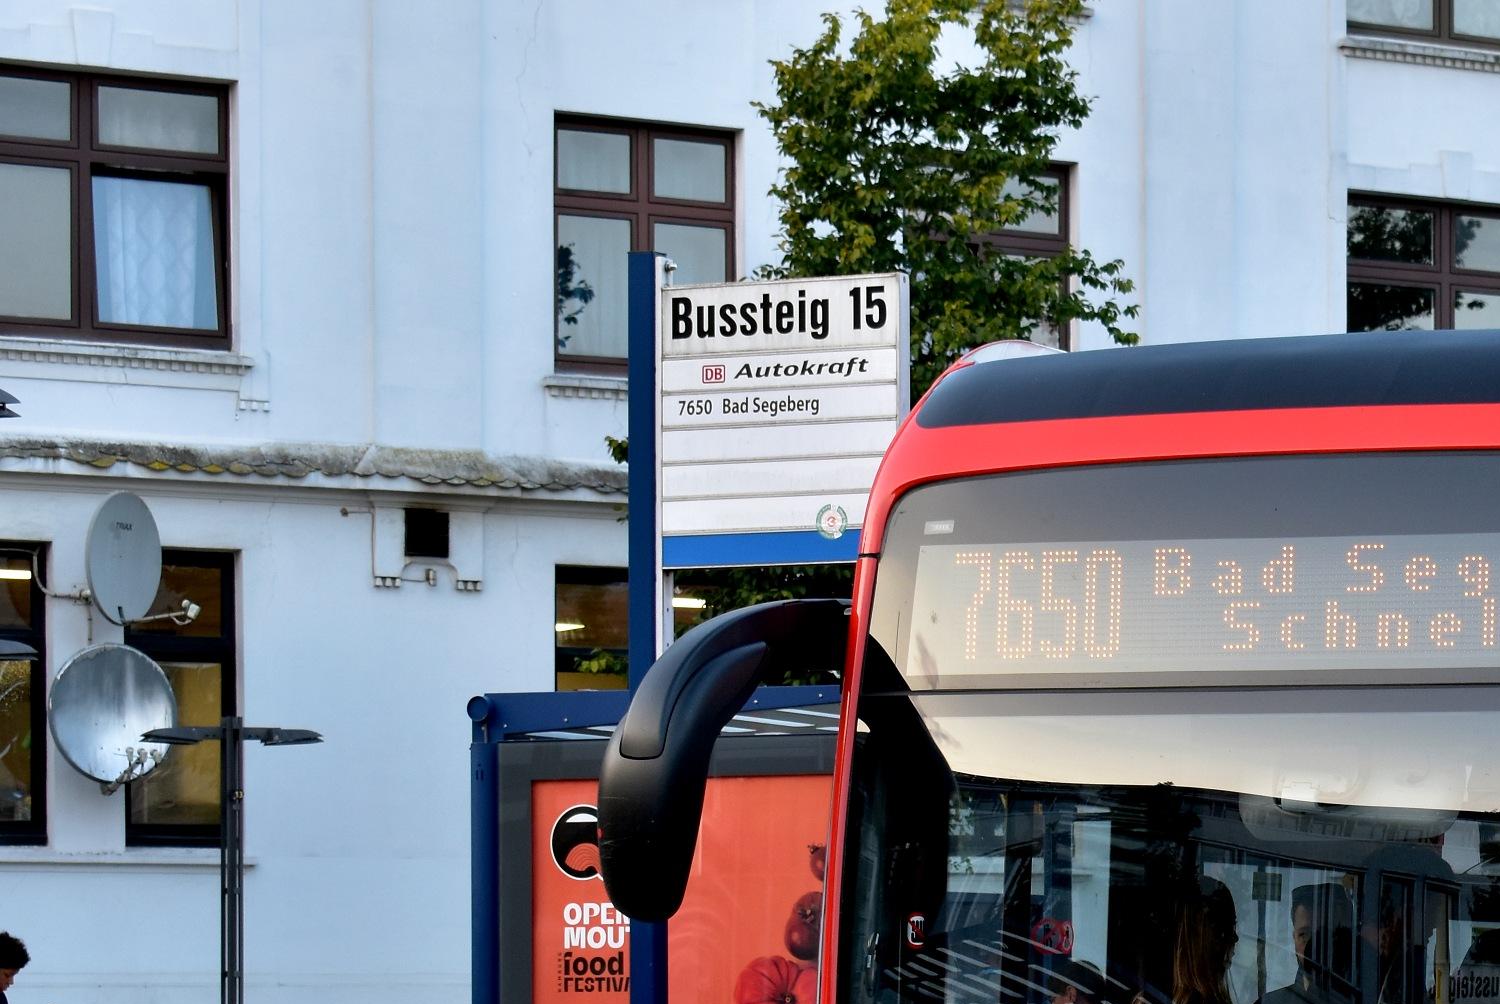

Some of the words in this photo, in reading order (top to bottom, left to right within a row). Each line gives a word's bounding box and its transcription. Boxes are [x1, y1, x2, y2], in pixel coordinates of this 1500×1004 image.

[671, 289, 830, 341] Bussteig
[849, 285, 887, 331] 15
[704, 366, 724, 382] DB
[734, 357, 869, 379] Autokraft
[678, 399, 713, 416] 7650
[722, 397, 748, 415] Bad
[753, 396, 820, 417] Segeberg
[954, 548, 1123, 661] 7650
[1152, 544, 1295, 597] Bad
[564, 926, 631, 949] MOU
[564, 951, 624, 976] food
